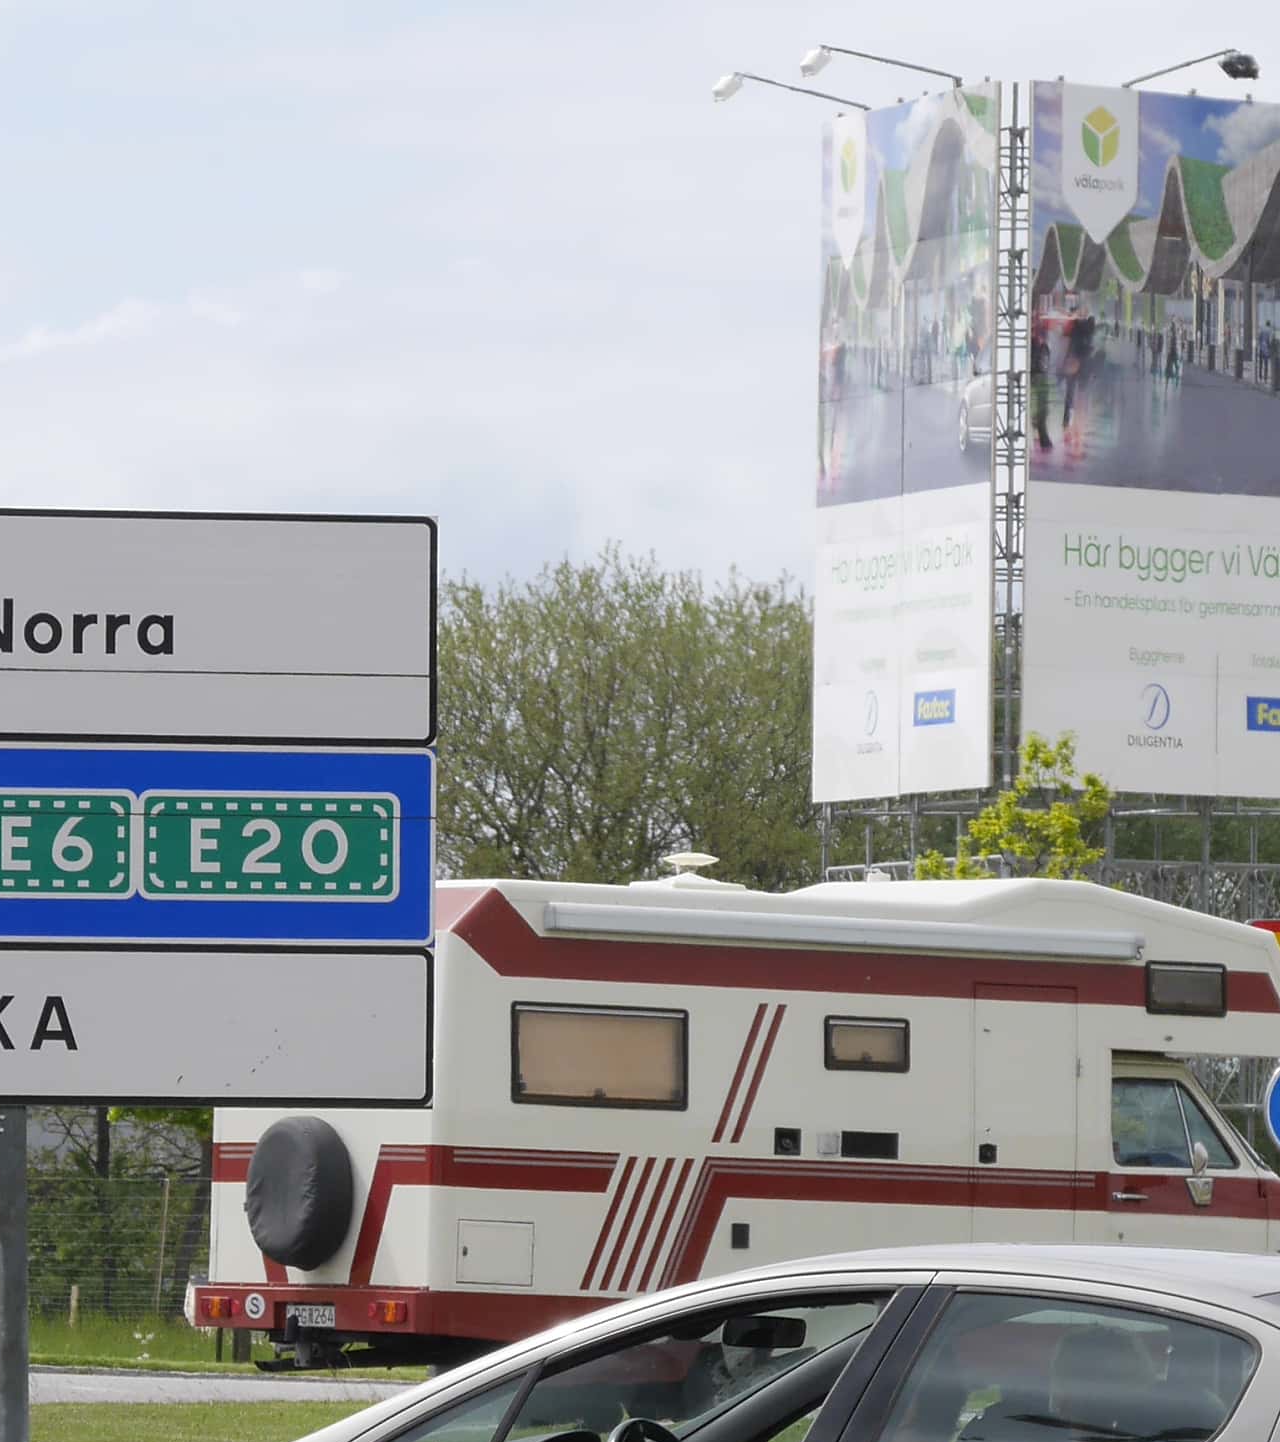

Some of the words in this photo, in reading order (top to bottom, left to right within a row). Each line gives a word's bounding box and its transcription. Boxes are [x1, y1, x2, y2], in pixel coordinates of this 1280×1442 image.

[1064, 533, 1111, 568] Här
[1119, 535, 1214, 583] bygger
[1222, 544, 1241, 576] vi
[1127, 734, 1184, 750] DILIGENTIA
[0, 815, 95, 872] E6
[190, 817, 349, 876] E20
[249, 1296, 260, 1316] S
